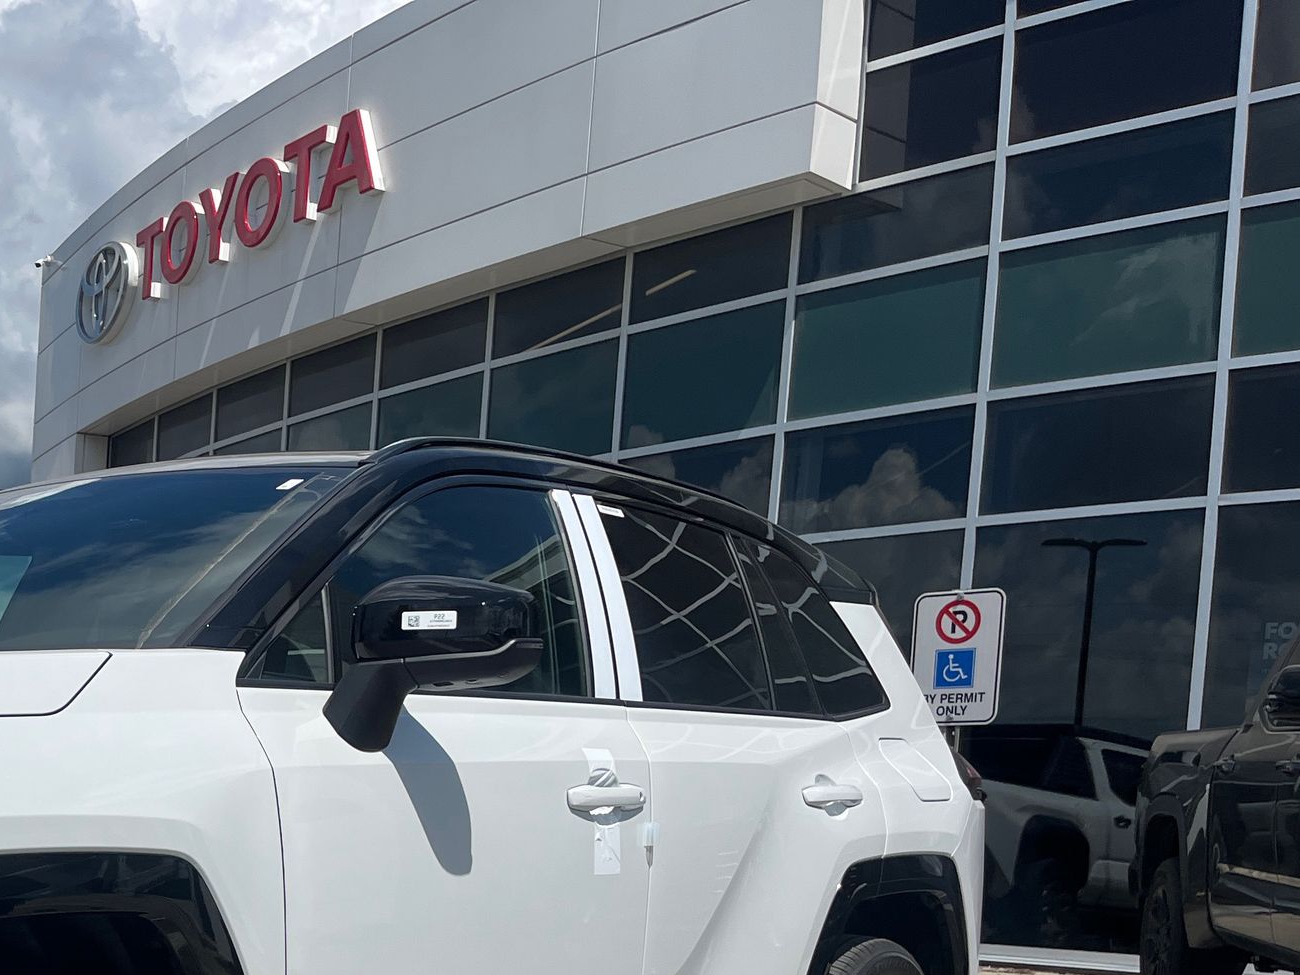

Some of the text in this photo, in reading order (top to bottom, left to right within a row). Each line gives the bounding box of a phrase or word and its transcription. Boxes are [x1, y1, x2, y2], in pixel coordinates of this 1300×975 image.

[136, 108, 384, 301] TOYOTA
[940, 692, 986, 704] PERMIT
[936, 705, 968, 716] ONLY
